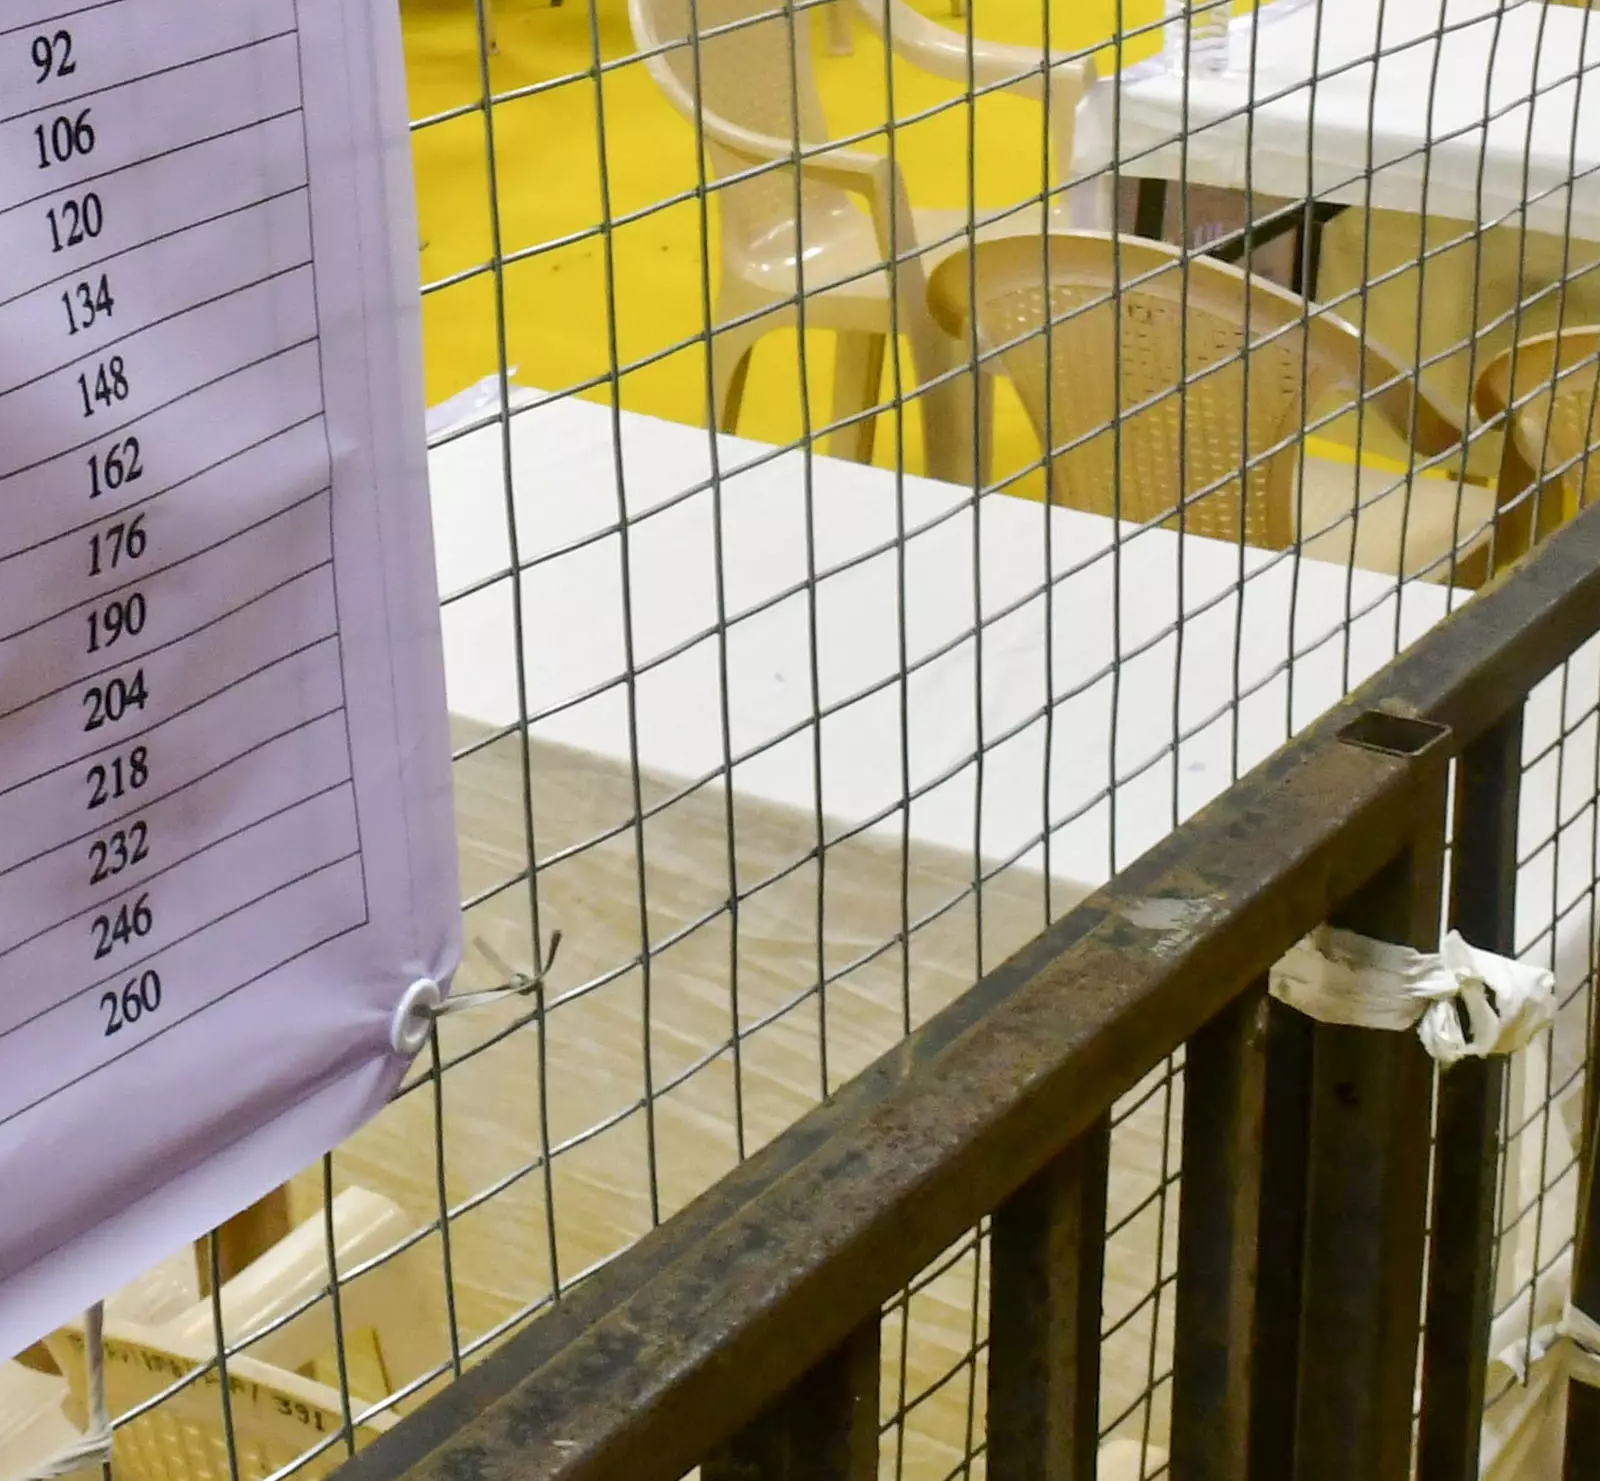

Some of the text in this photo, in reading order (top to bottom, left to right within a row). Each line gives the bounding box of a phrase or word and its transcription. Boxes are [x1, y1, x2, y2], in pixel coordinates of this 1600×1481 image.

[31, 30, 76, 84] 92
[34, 108, 95, 169] 106
[46, 192, 103, 253] 120
[62, 274, 114, 335] 134
[78, 356, 128, 417] 148
[88, 437, 143, 498] 162
[89, 512, 146, 576] 176
[87, 593, 146, 653] 190
[84, 669, 148, 731] 204
[87, 746, 148, 809] 218
[89, 820, 148, 886] 232
[92, 892, 152, 960] 246
[100, 970, 161, 1036] 260
